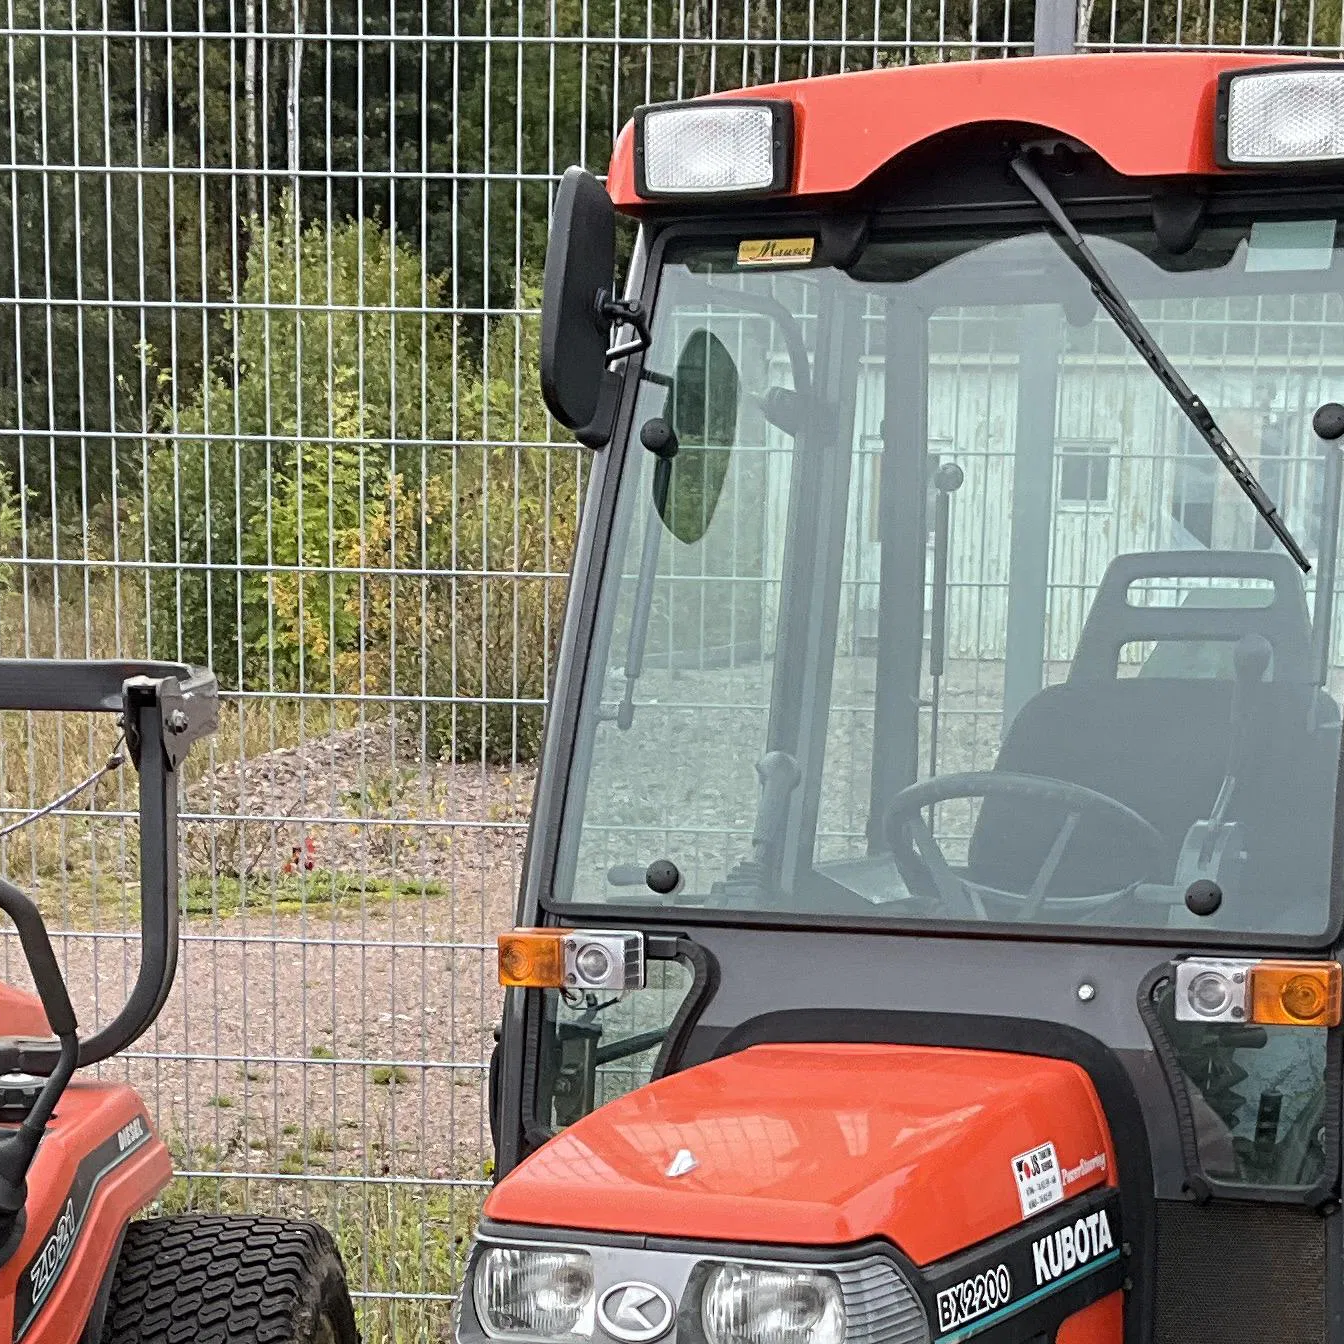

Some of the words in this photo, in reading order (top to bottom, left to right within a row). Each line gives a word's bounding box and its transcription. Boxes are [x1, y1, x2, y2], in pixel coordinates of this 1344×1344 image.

[30, 1197, 76, 1305] ZD21
[1032, 1209, 1114, 1286] KUBOTA
[936, 1264, 1011, 1333] BX2200
